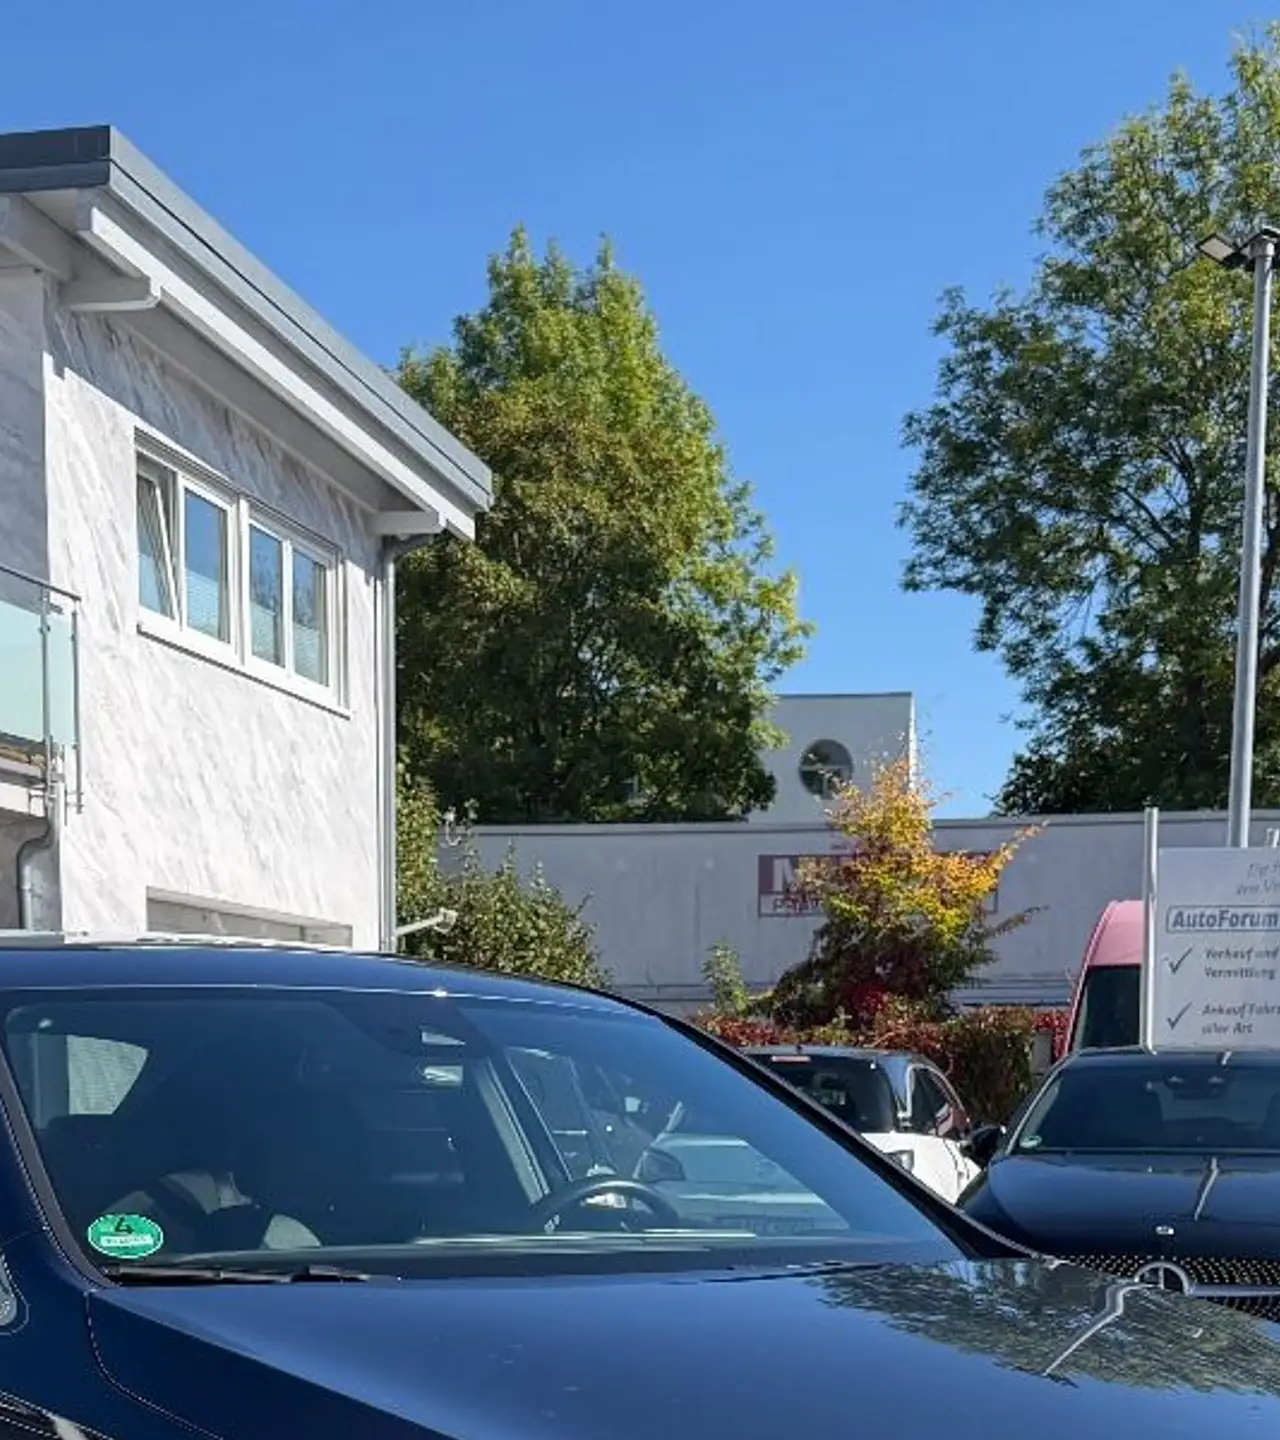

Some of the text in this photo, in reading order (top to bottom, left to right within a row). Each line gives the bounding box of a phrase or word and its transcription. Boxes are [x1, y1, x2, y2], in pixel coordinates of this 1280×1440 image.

[1172, 910, 1278, 930] AutoForum
[1205, 947, 1253, 961] Verkauf
[1233, 1022, 1253, 1034] Art
[114, 1217, 134, 1234] 4
